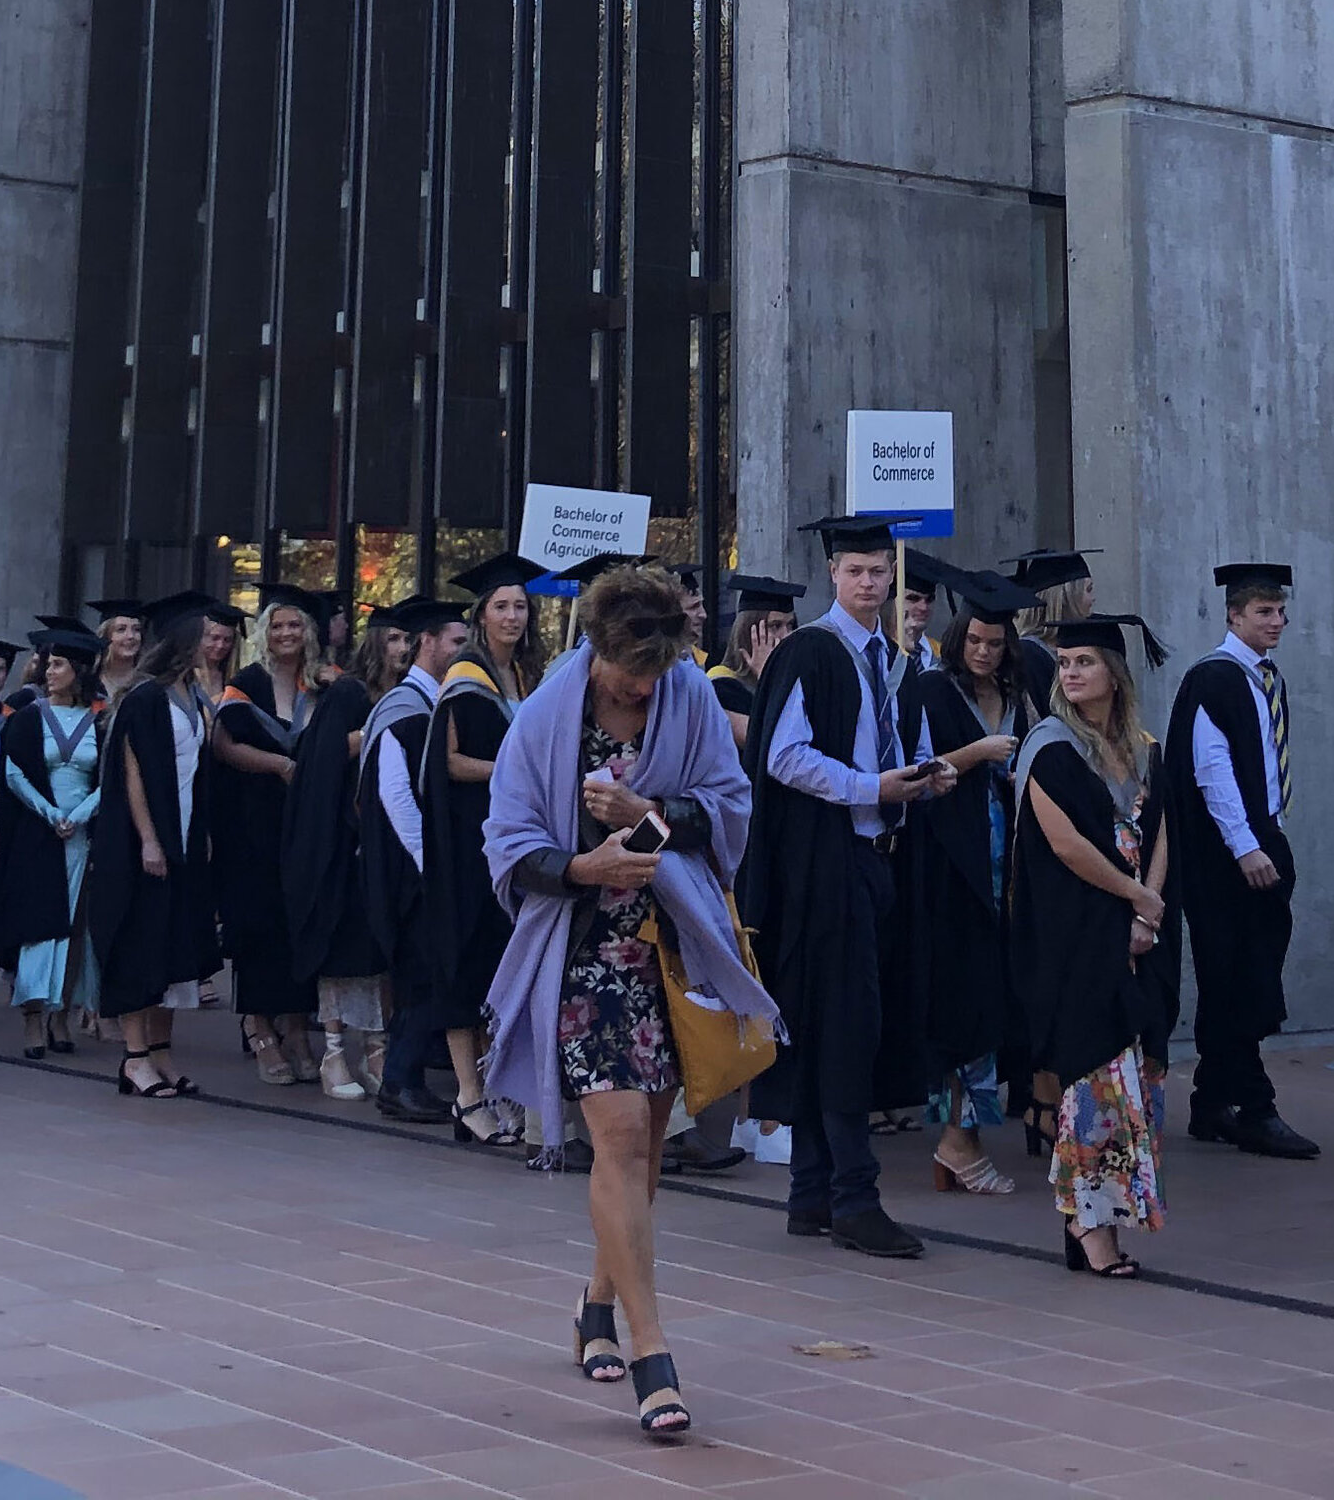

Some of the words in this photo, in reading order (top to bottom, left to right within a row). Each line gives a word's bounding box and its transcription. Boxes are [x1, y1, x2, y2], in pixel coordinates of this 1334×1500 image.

[872, 441, 921, 459] Bachelor
[924, 441, 935, 459] of
[872, 465, 935, 481] Commerce
[554, 505, 608, 523] Bachelor
[610, 511, 624, 525] of
[552, 523, 620, 542] Commerce
